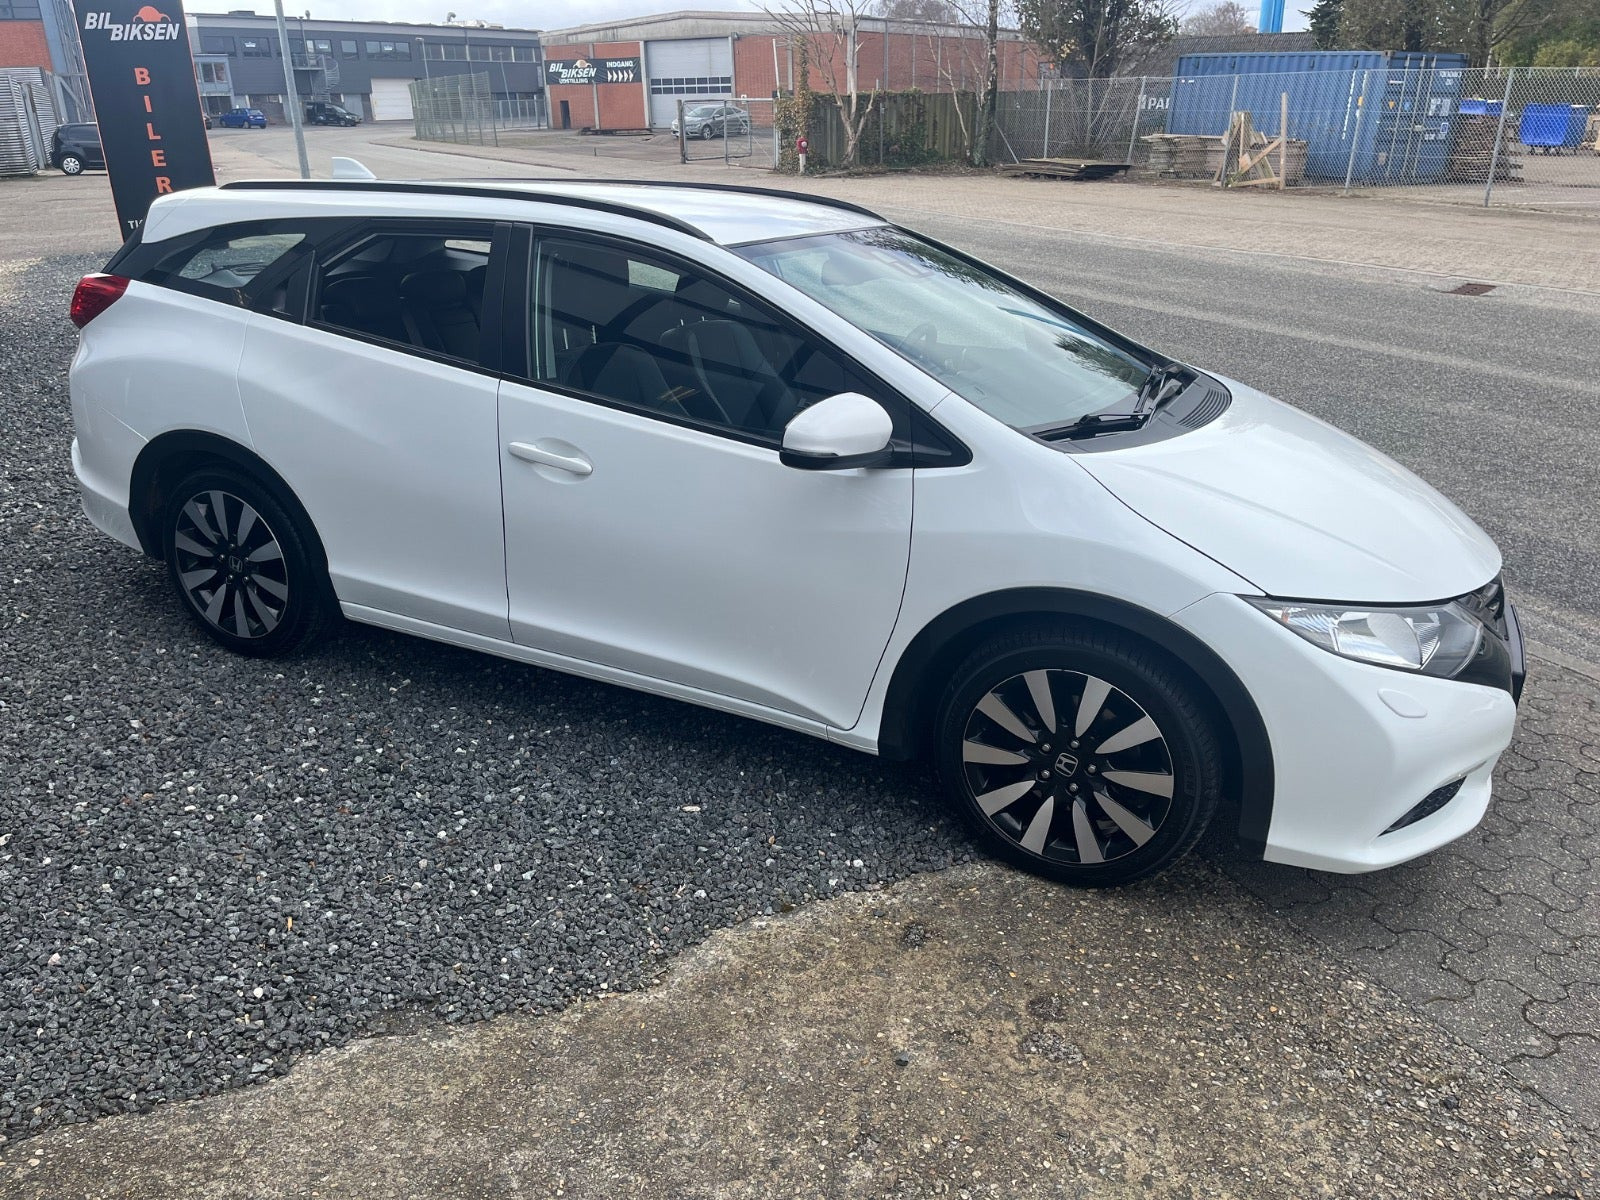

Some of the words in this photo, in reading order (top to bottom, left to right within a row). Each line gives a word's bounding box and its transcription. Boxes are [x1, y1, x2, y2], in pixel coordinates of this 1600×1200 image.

[85, 12, 114, 30] BIL
[110, 23, 180, 41] BIKSEN
[549, 63, 564, 73] BIL
[561, 68, 597, 78] BIKSEN
[134, 67, 173, 193] BILER
